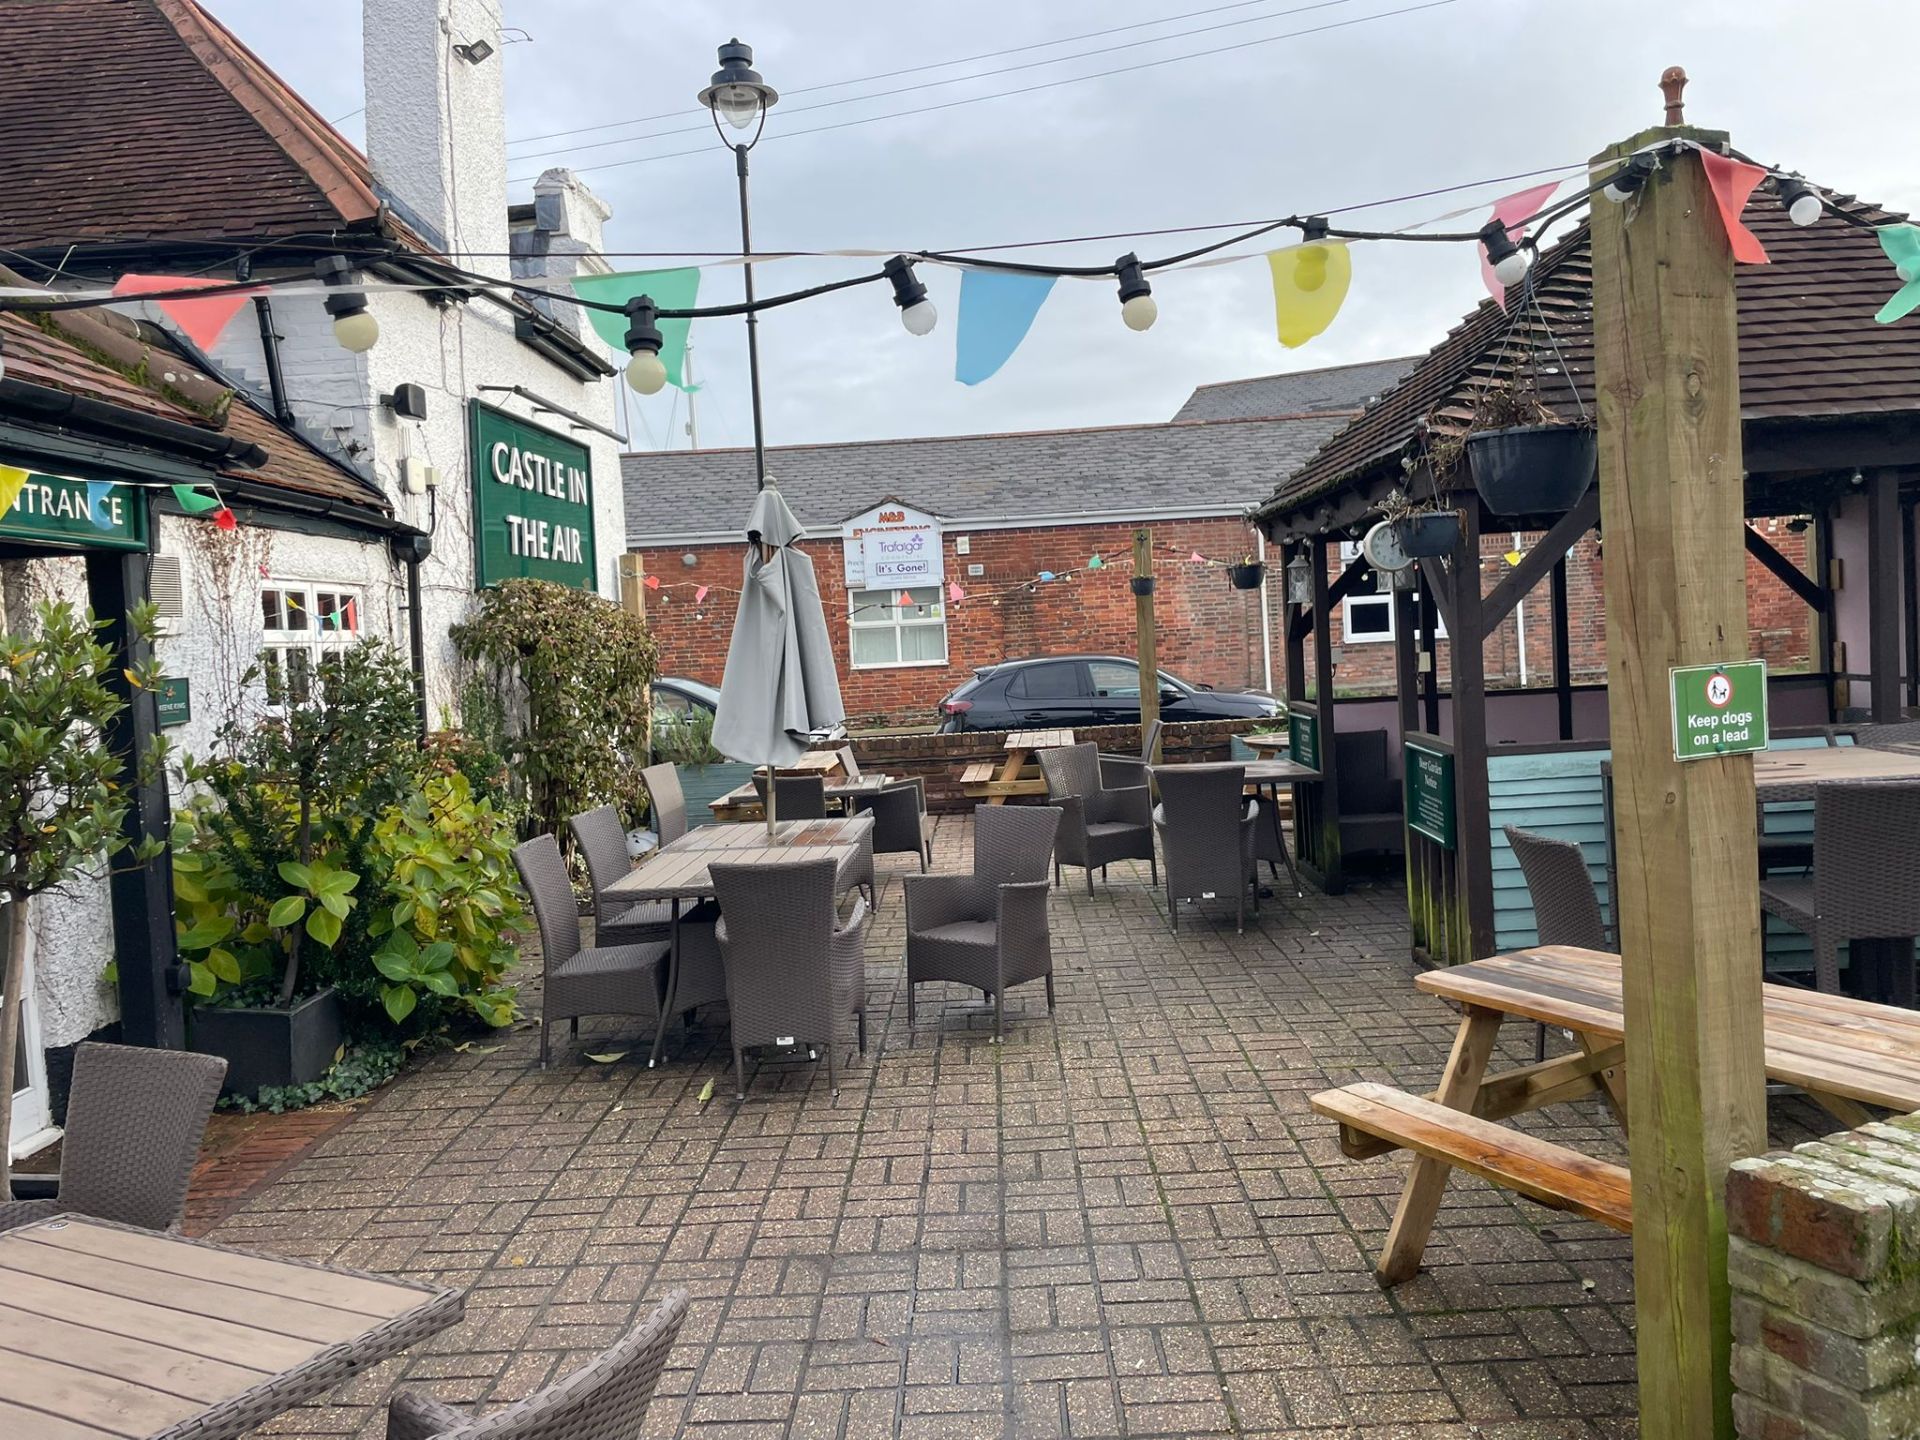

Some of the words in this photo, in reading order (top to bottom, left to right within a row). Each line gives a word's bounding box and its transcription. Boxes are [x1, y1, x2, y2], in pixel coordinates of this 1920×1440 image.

[491, 442, 566, 499] CASTLE
[567, 467, 588, 505] IN
[879, 511, 905, 523] M&B
[506, 514, 550, 560] THE
[551, 524, 583, 564] AIR
[879, 540, 924, 555] Trafalgar
[878, 565, 893, 574] It's
[897, 563, 926, 573] Gone!
[1687, 714, 1719, 729] Keep
[1721, 711, 1753, 726] dogs
[1693, 734, 1709, 746] on
[1712, 733, 1720, 744] a
[1722, 727, 1749, 742] lead
